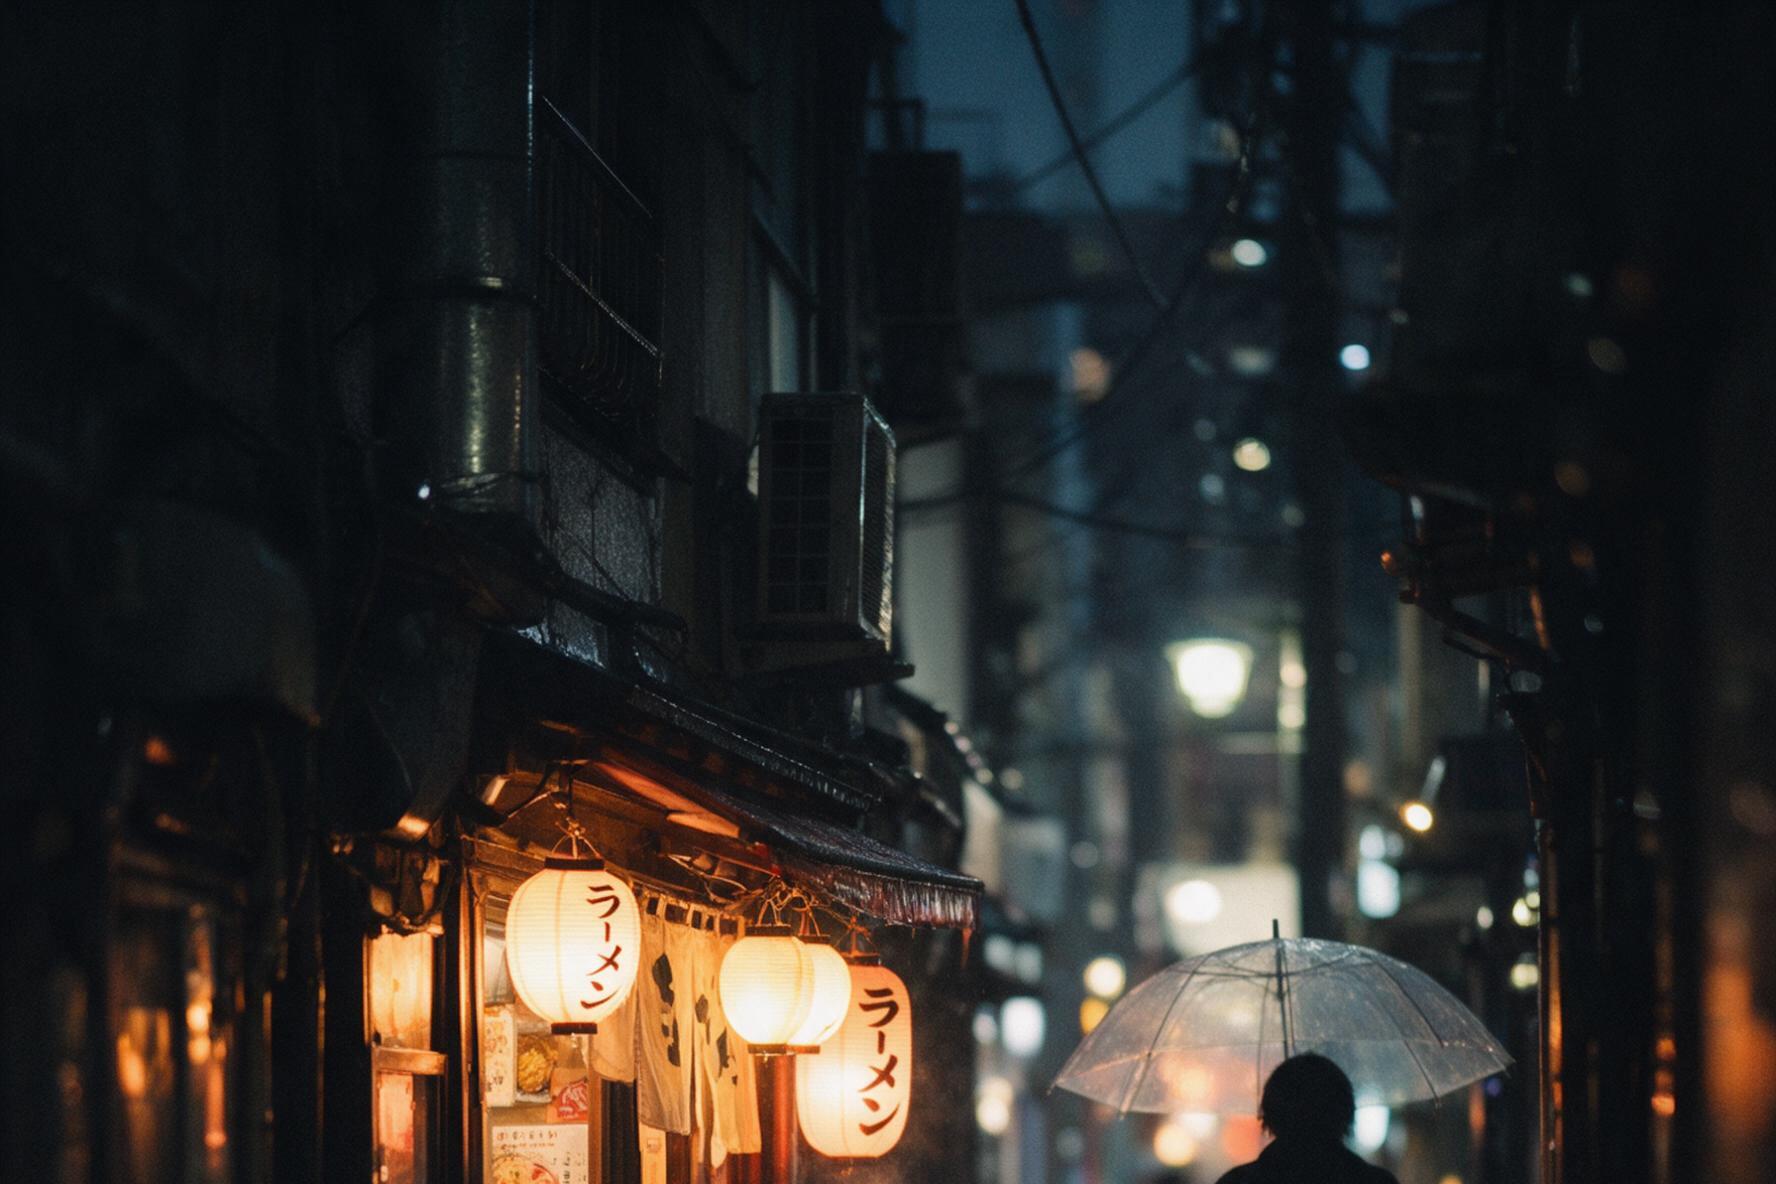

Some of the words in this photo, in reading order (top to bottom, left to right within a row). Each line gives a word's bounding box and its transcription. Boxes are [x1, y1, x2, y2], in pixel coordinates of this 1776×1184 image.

[581, 884, 621, 1009] ラーメン
[859, 988, 899, 1136] ラーメン
